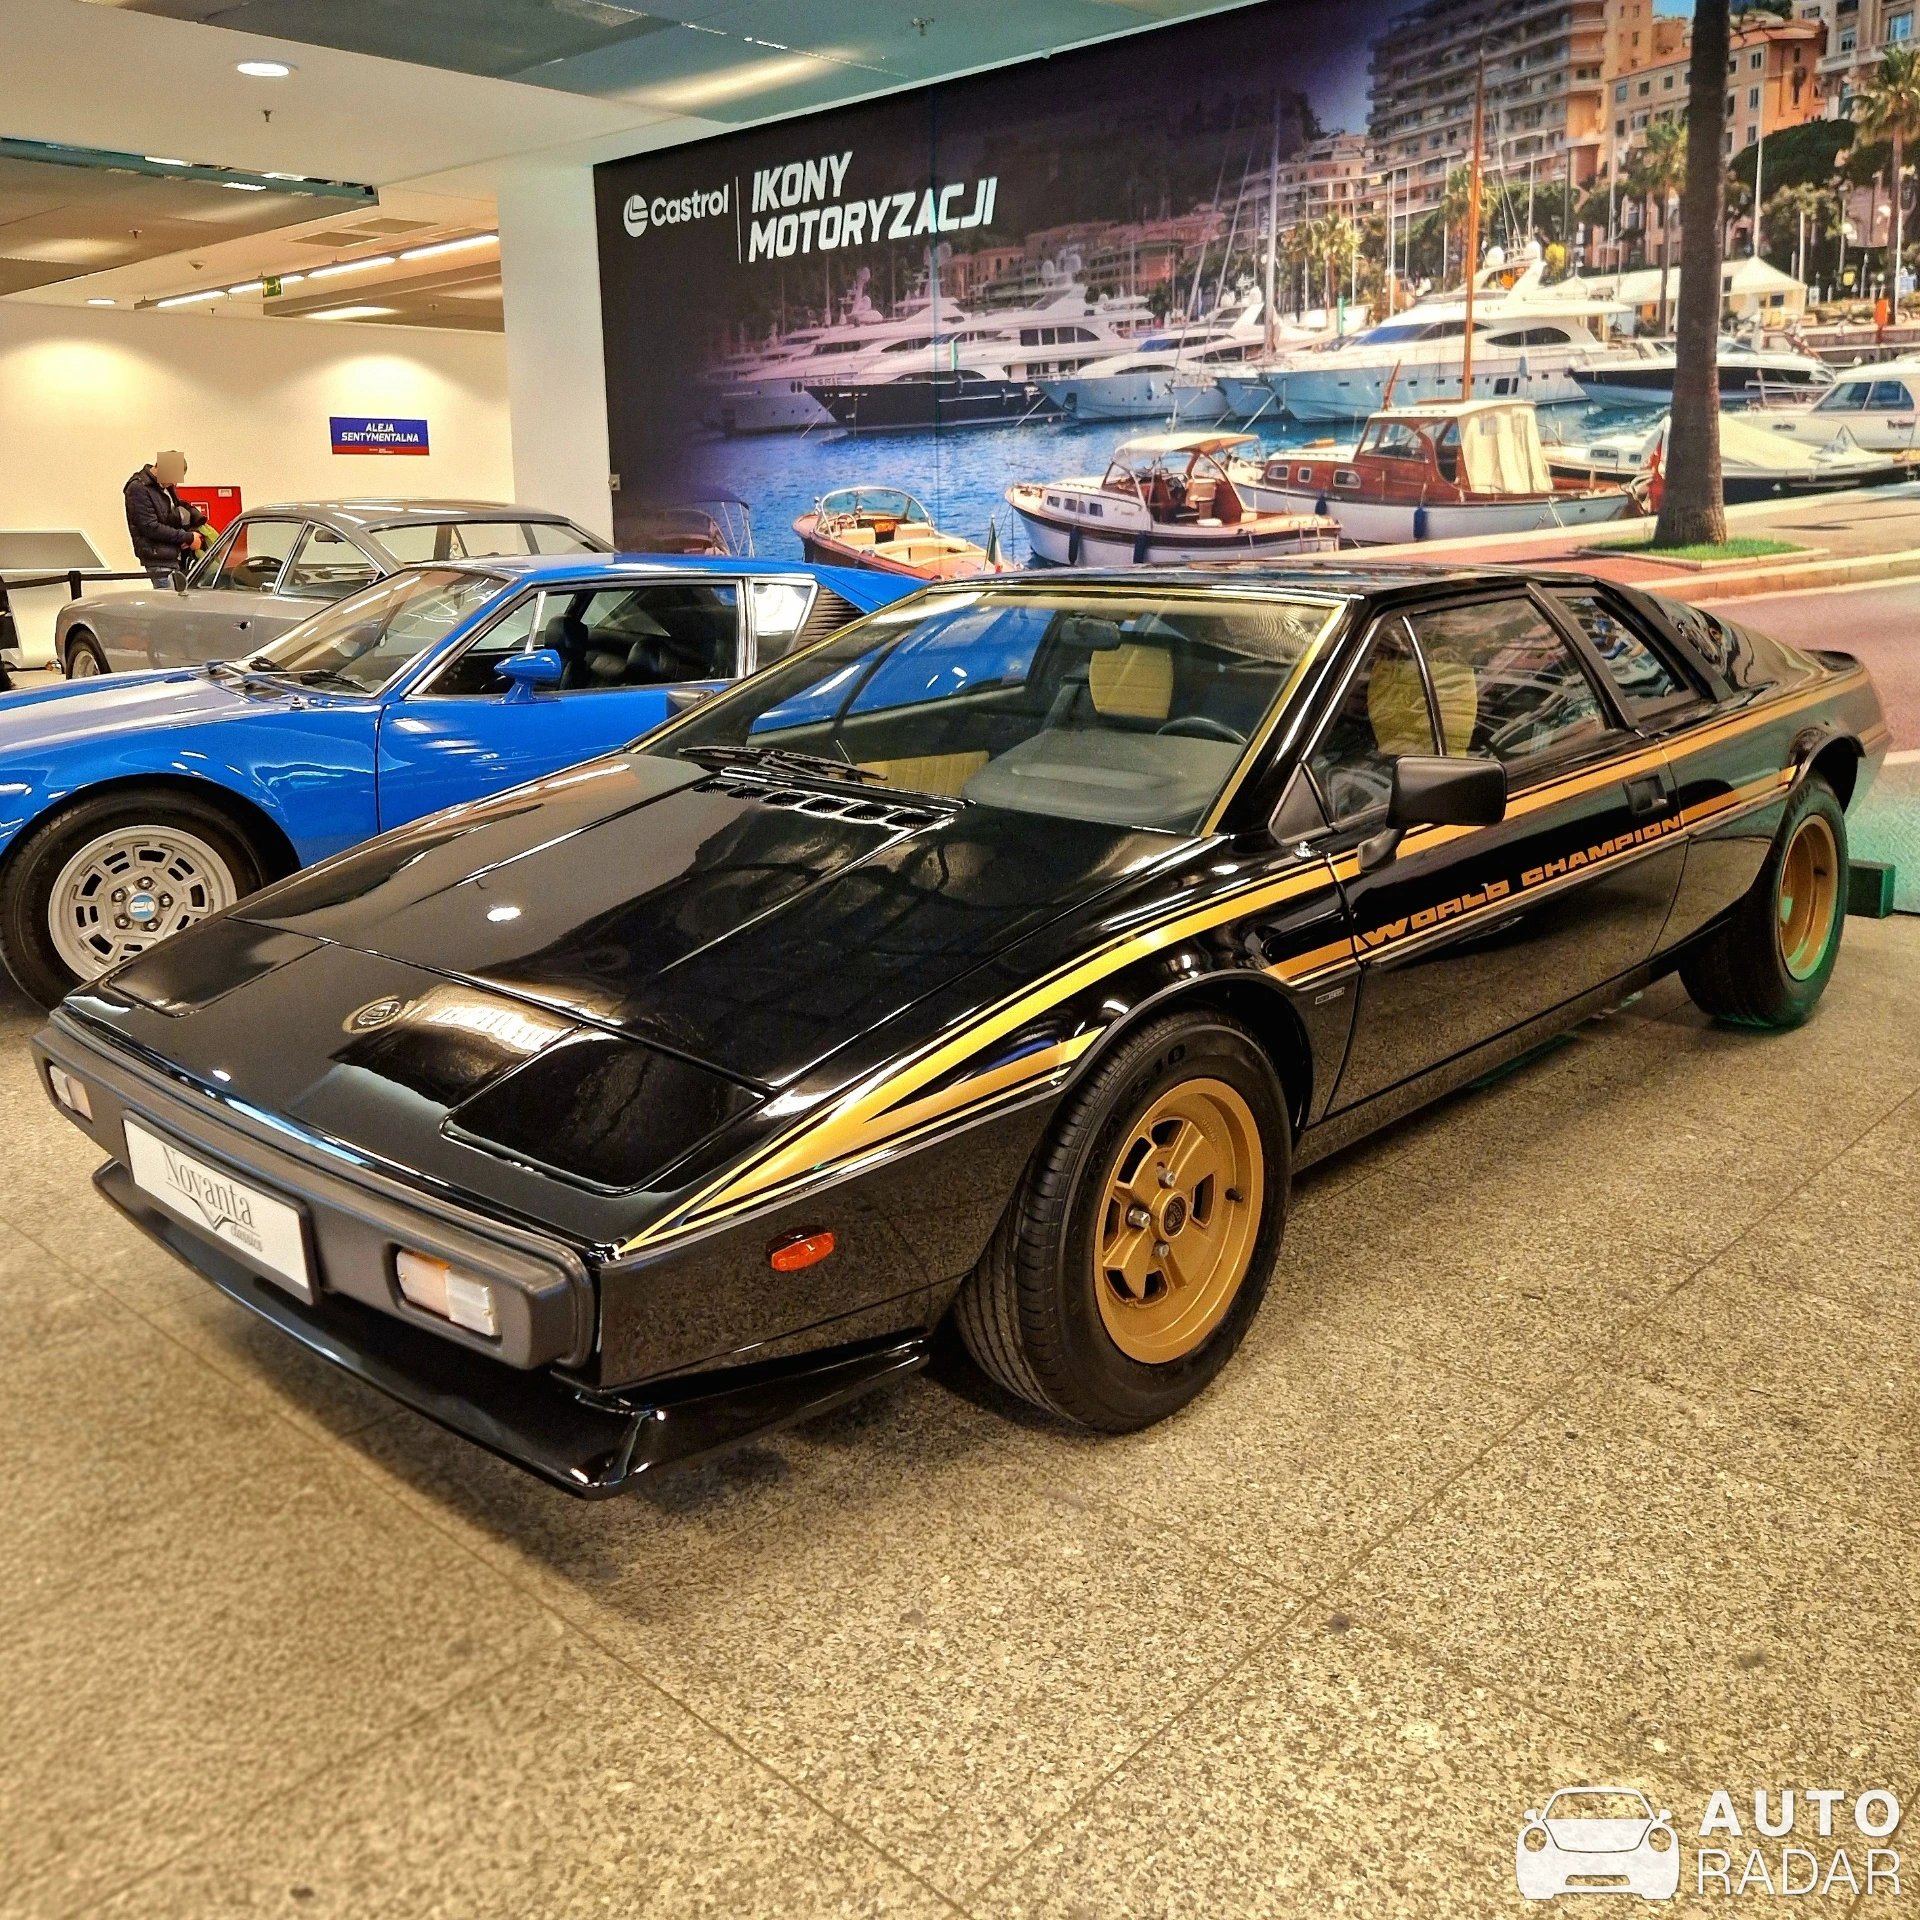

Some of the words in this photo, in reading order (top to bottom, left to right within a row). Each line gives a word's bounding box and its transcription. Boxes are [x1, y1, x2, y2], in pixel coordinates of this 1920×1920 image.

[651, 184, 729, 227] Castrol
[751, 151, 854, 214] IKONY
[748, 177, 998, 264] MOTORYZACJI
[341, 432, 419, 443] SENTYMENTALNA
[365, 422, 395, 432] ALEJA
[1364, 879, 1510, 946] WORLD
[1521, 815, 1680, 887] CHAMPION
[161, 1145, 256, 1229] Novanta
